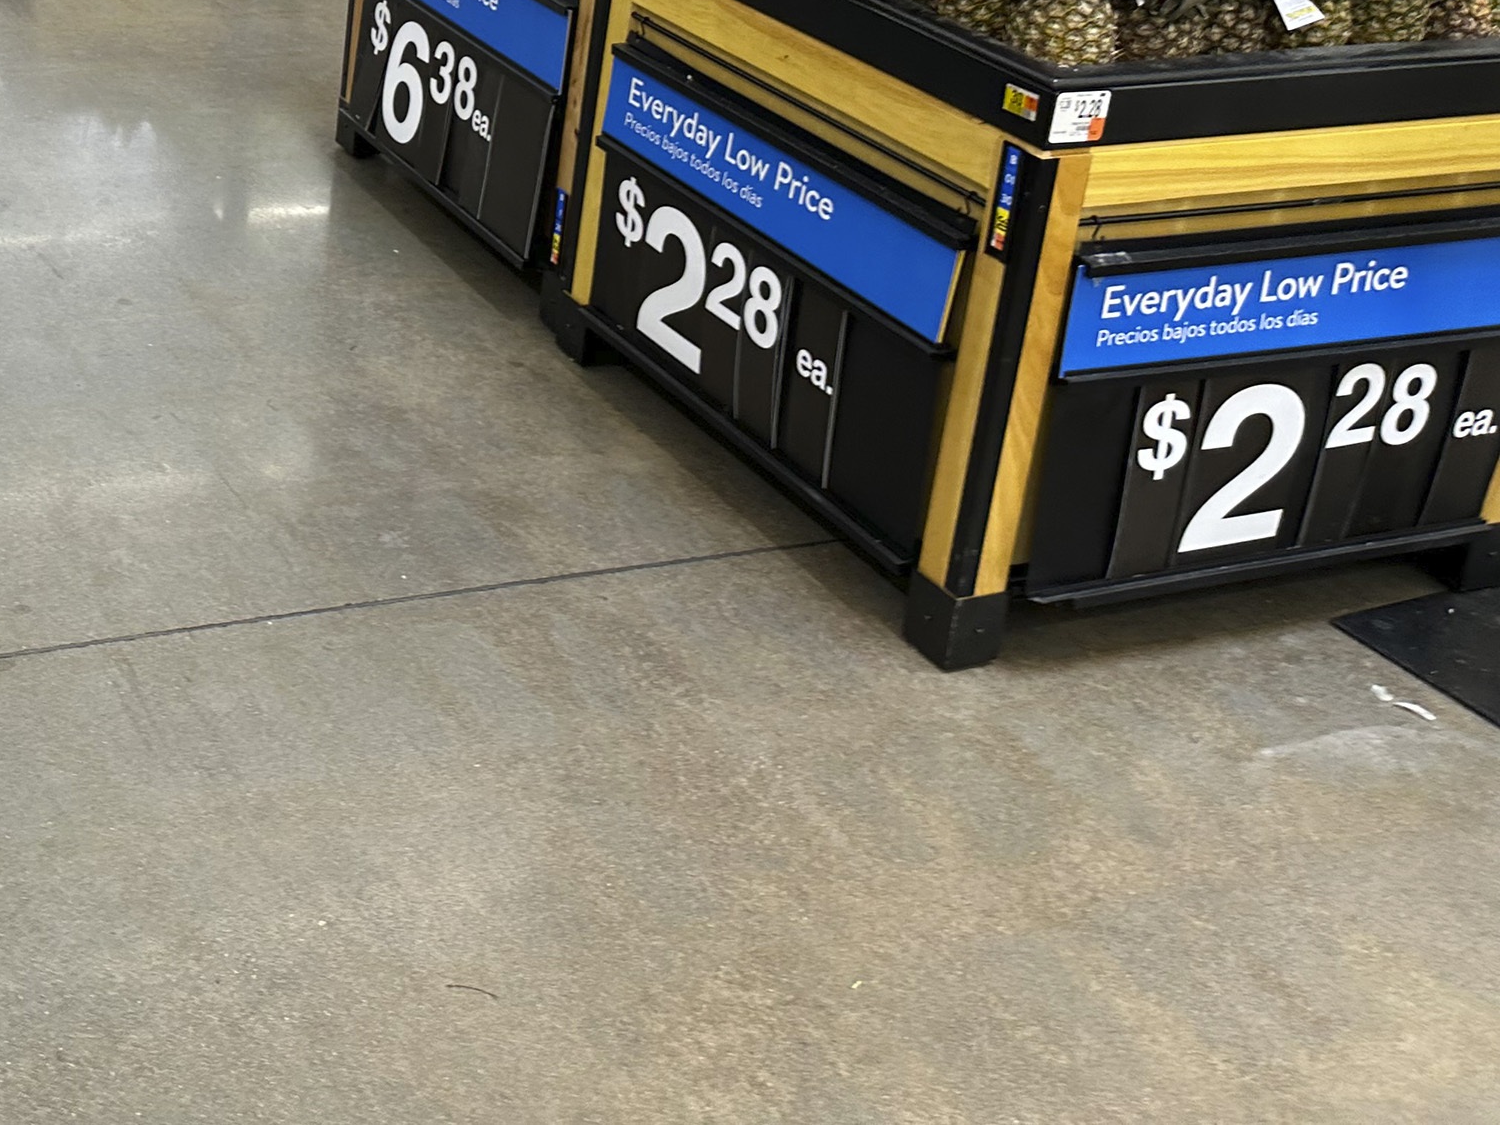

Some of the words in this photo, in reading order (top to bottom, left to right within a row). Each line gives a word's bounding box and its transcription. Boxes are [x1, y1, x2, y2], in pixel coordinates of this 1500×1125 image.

[472, 109, 492, 142] ea.
[628, 77, 722, 160] Everyday
[724, 133, 771, 182] Low
[773, 161, 834, 220] Price
[624, 112, 660, 148] Precios
[661, 130, 689, 163] bajos
[689, 144, 721, 180] todos
[722, 164, 740, 192] los
[740, 175, 763, 209] días
[1101, 280, 1252, 320] Everyday
[1260, 271, 1323, 305] Low
[1331, 261, 1410, 297] Price
[1096, 324, 1160, 348] Precios
[1162, 320, 1206, 345] bajos
[1209, 315, 1255, 336] todos
[1259, 312, 1283, 330] los
[1286, 307, 1319, 328] días
[796, 348, 833, 396] ea.
[1453, 408, 1498, 440] ea.
